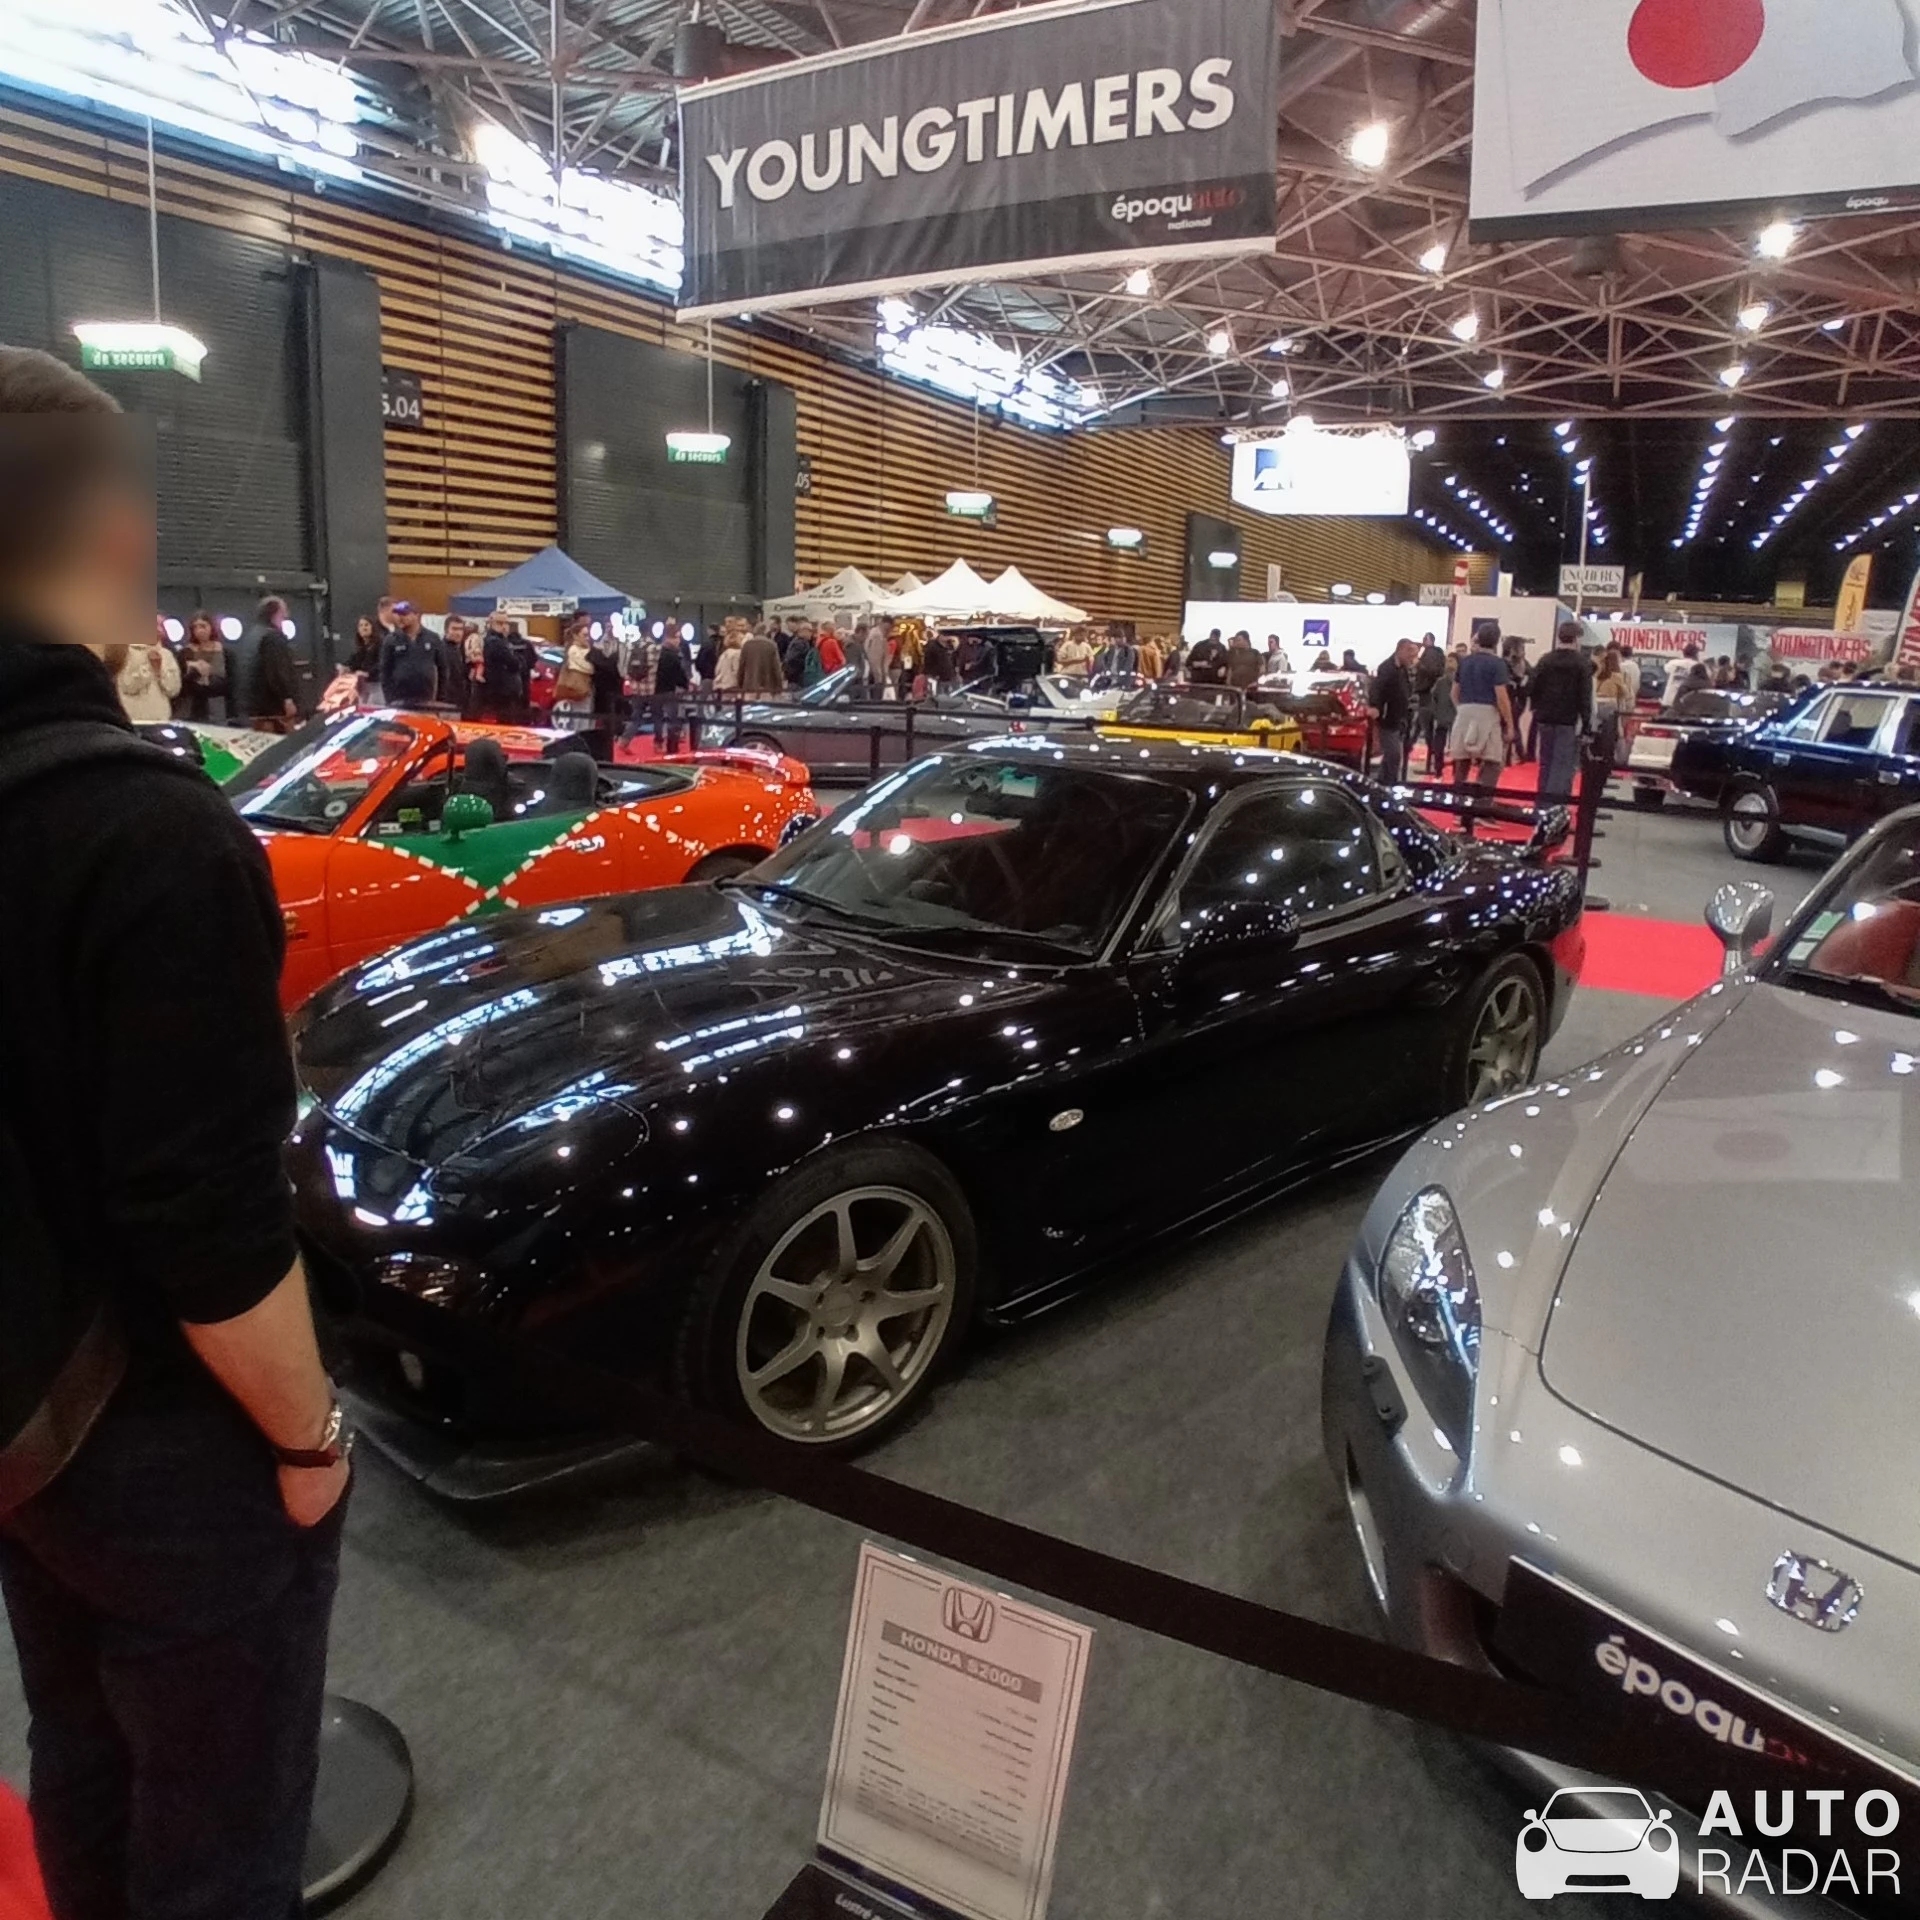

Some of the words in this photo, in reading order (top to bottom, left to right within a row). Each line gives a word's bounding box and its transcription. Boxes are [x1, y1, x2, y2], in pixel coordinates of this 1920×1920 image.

[706, 57, 1235, 208] YOUNGTIMERS
[1610, 626, 1707, 652] YOUNGTIMERS
[1771, 633, 1872, 662] YOUNGTIMERS
[899, 1631, 963, 1668] HONDA
[966, 1657, 1023, 1692] S2000
